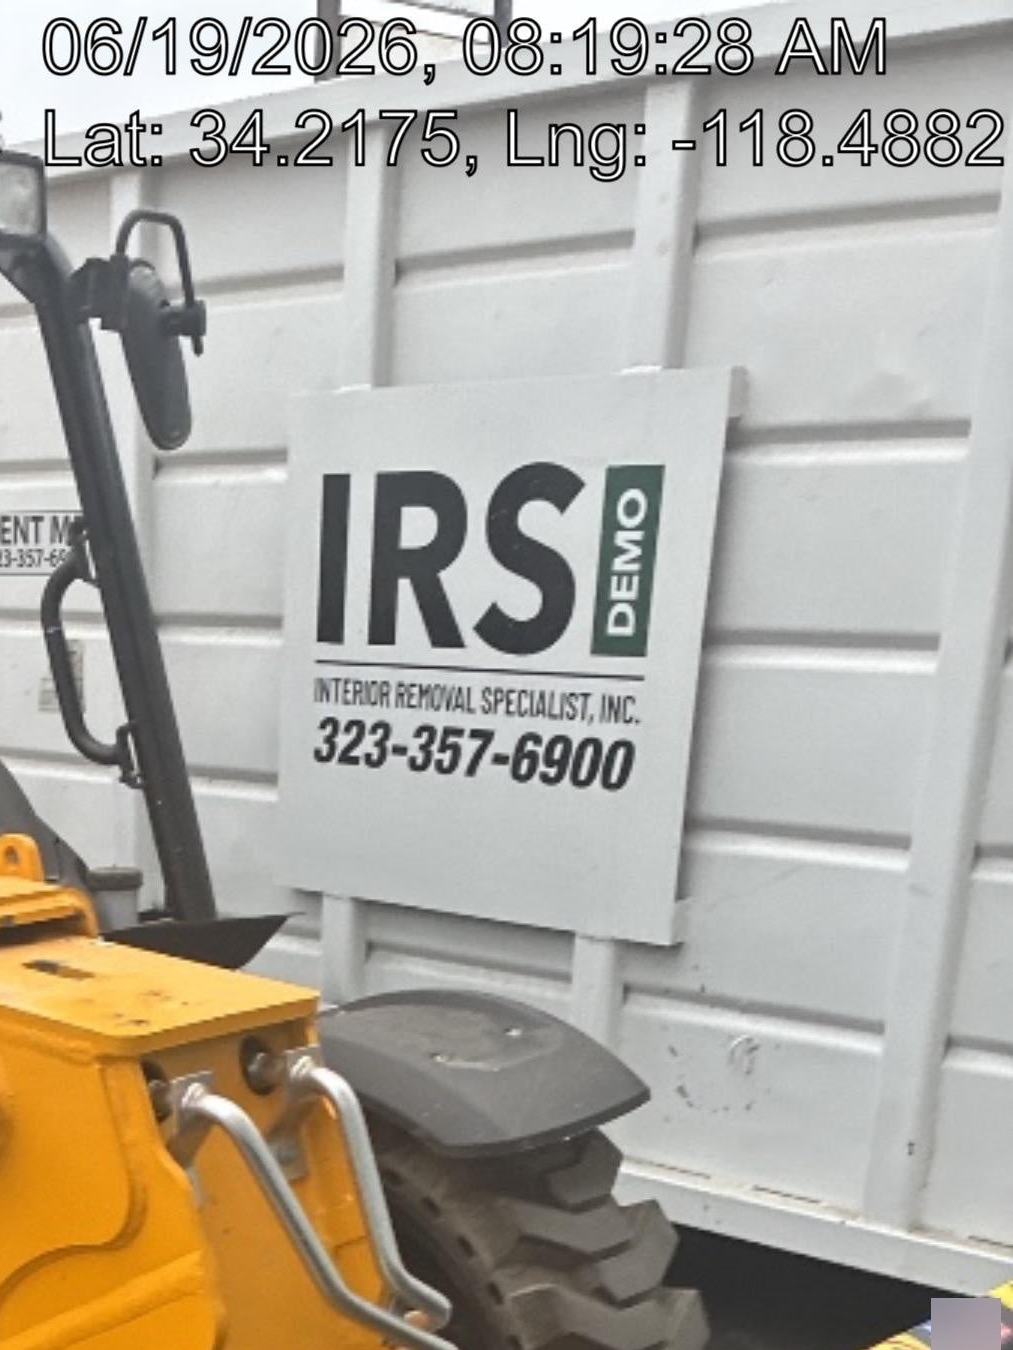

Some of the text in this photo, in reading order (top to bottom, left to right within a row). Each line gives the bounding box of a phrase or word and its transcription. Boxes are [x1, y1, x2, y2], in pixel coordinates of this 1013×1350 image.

[316, 461, 586, 656] IRS
[606, 487, 649, 637] DEMO
[313, 716, 637, 792] 323-357-6900
[314, 677, 641, 726] INTERIOR REMOVAL SPECIALIST, INC.
